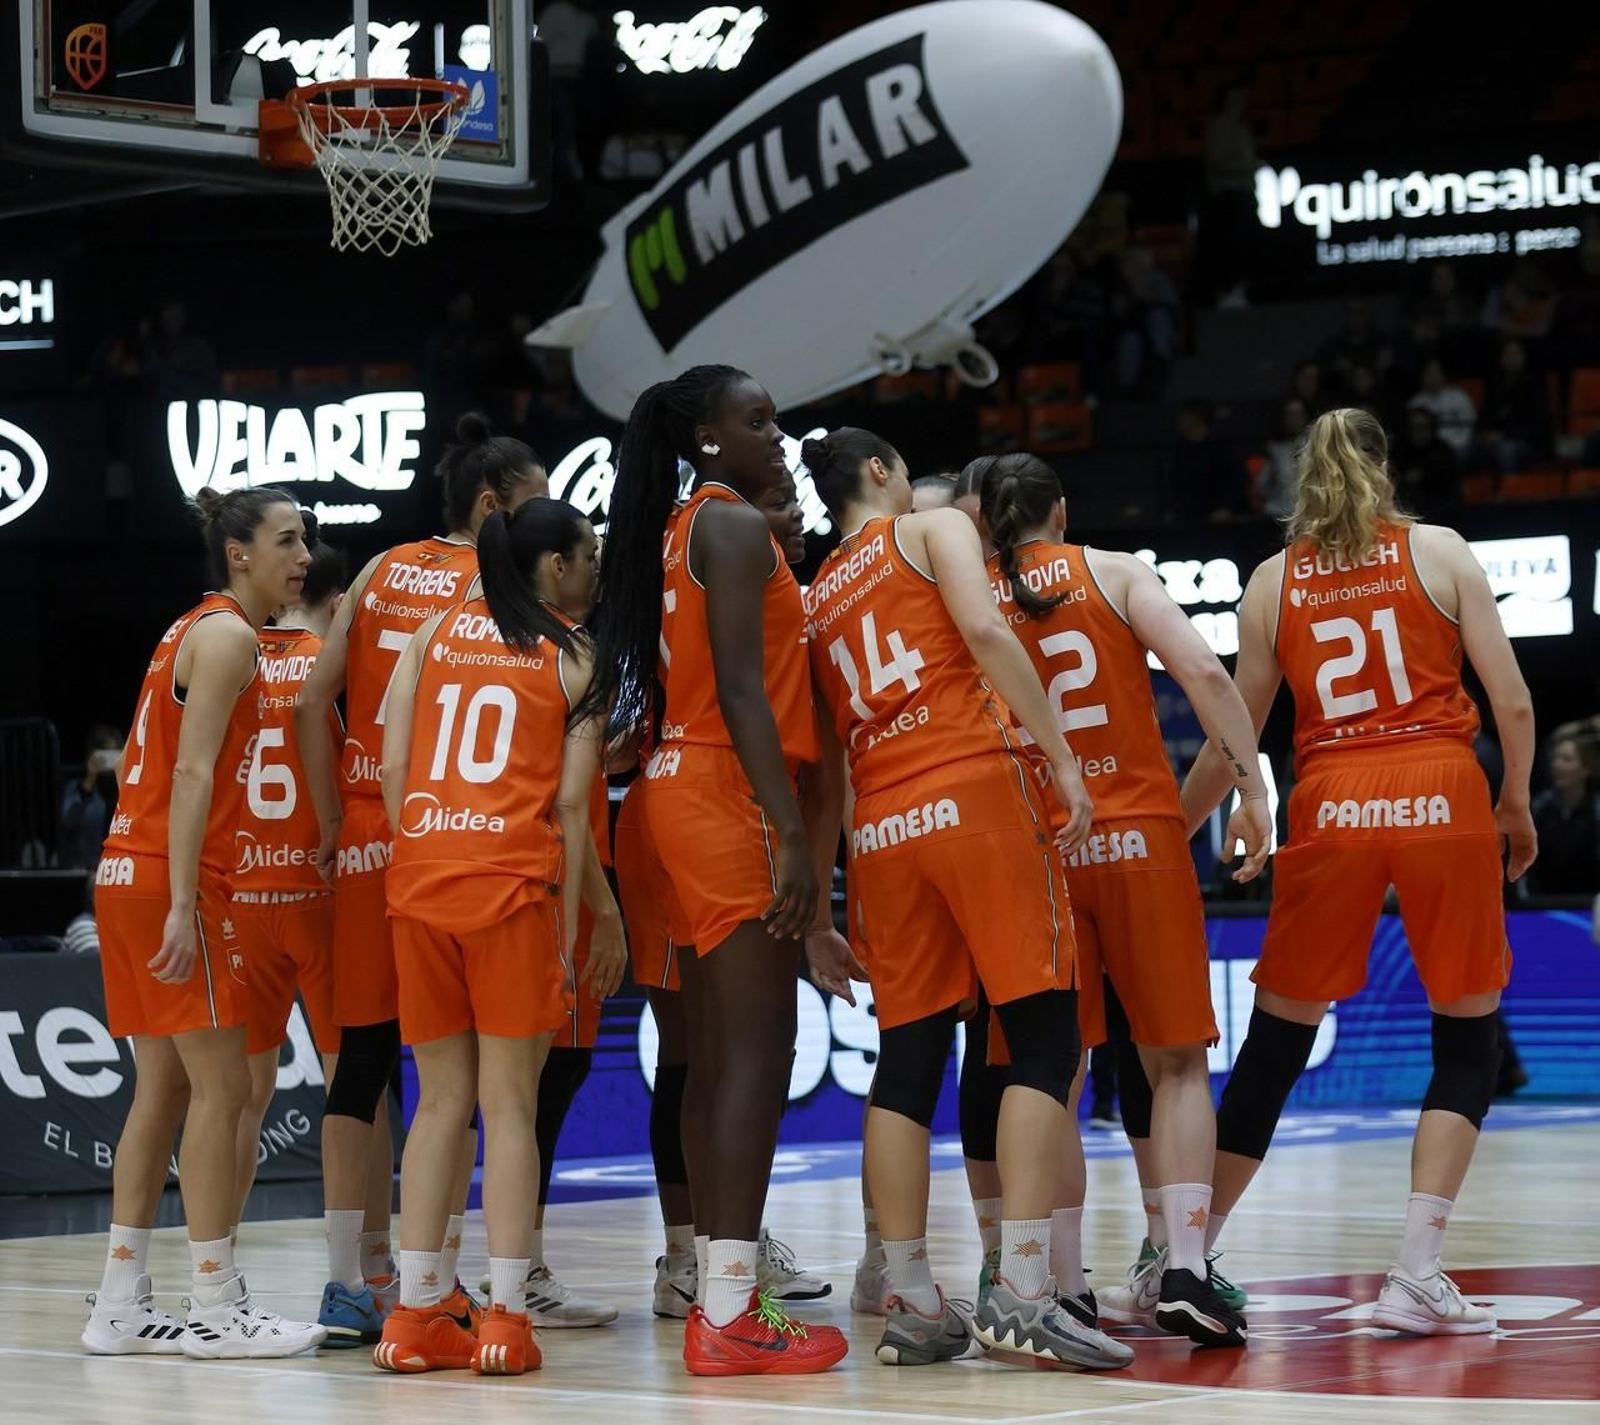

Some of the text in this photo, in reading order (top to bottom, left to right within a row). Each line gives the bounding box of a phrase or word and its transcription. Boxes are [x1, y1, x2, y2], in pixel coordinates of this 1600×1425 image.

[685, 62, 938, 266] MILAR
[166, 391, 426, 504] VELARTE
[383, 561, 463, 598] TORRENS
[827, 610, 926, 723] 14
[1309, 606, 1414, 721] 21
[429, 683, 517, 784] 10
[246, 726, 297, 820] 6
[1316, 793, 1451, 829] PAMESA
[235, 836, 321, 874] Midea
[401, 796, 506, 838] Midea
[852, 797, 961, 859] PAMESA
[43, 1121, 80, 1158] EL
